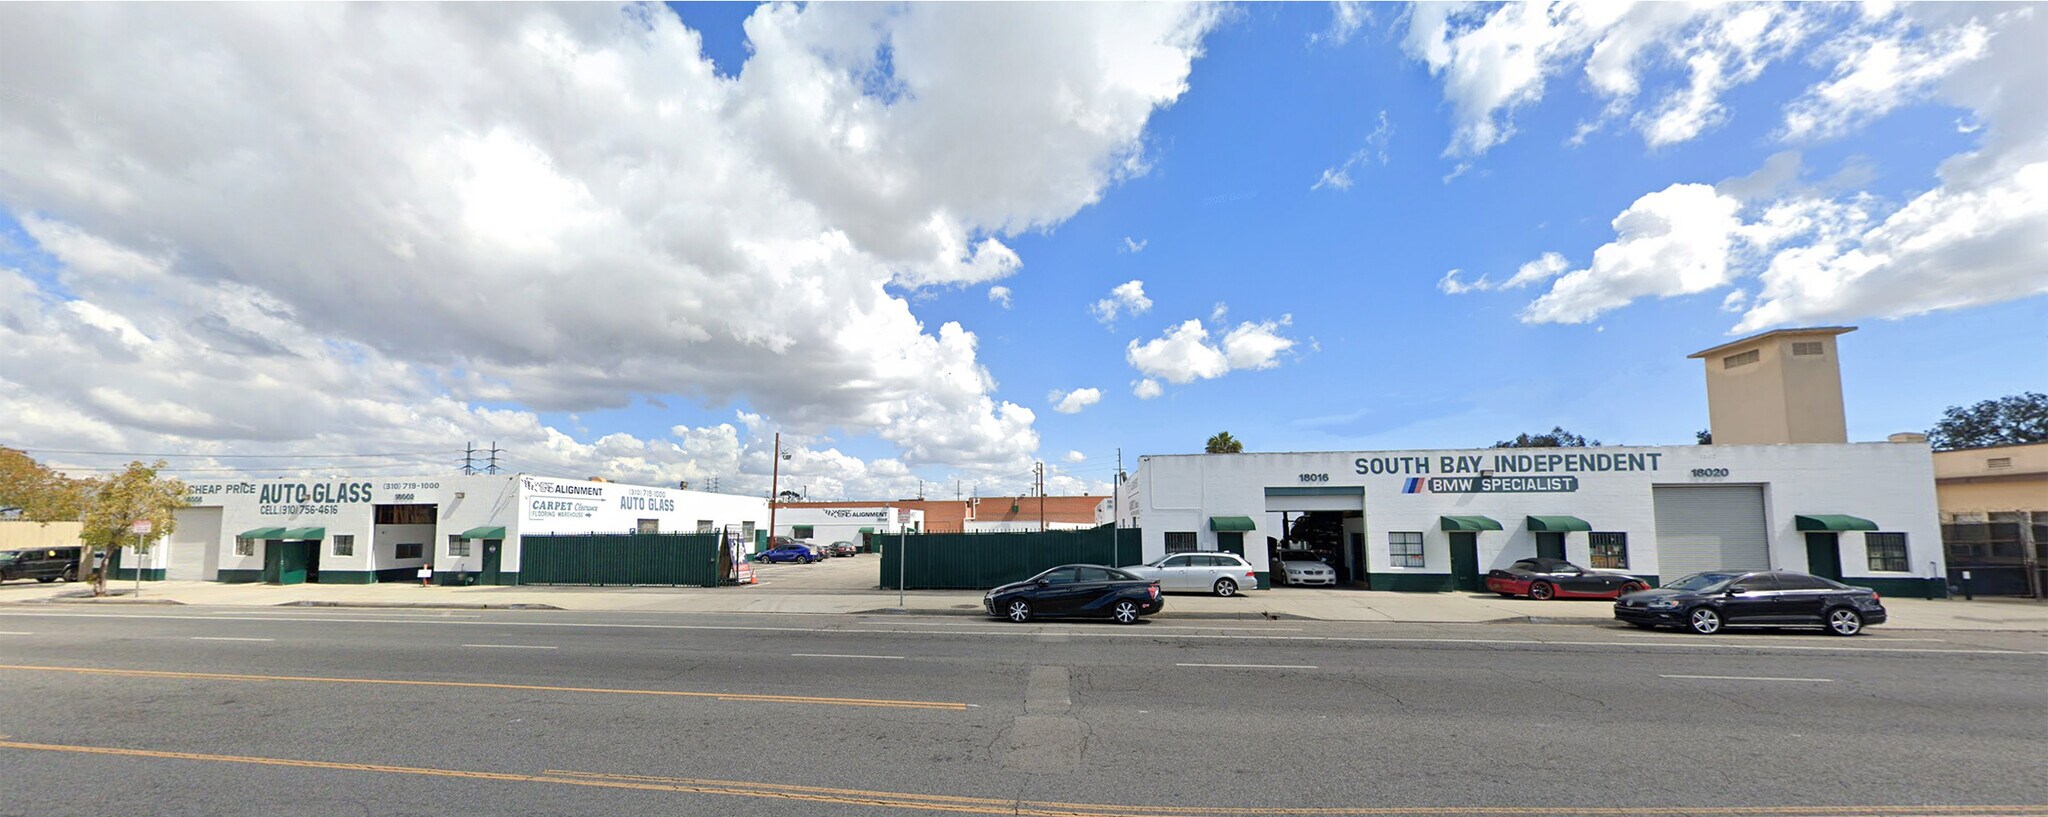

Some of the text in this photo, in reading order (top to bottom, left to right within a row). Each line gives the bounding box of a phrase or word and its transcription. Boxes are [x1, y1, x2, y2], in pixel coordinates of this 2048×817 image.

[1355, 453, 1662, 475] SOUTH BAY INDEPENDENT
[1299, 473, 1329, 482] 18016
[1690, 468, 1730, 477] 18020
[188, 484, 256, 494] CHEAP PRICE
[1432, 478, 1572, 491] BMW SPECIALIST
[259, 482, 373, 504] AUTO GLASS
[555, 485, 602, 496] ALIGNMENT
[532, 500, 573, 511] CARPET
[620, 496, 675, 512] AUTO GLASS
